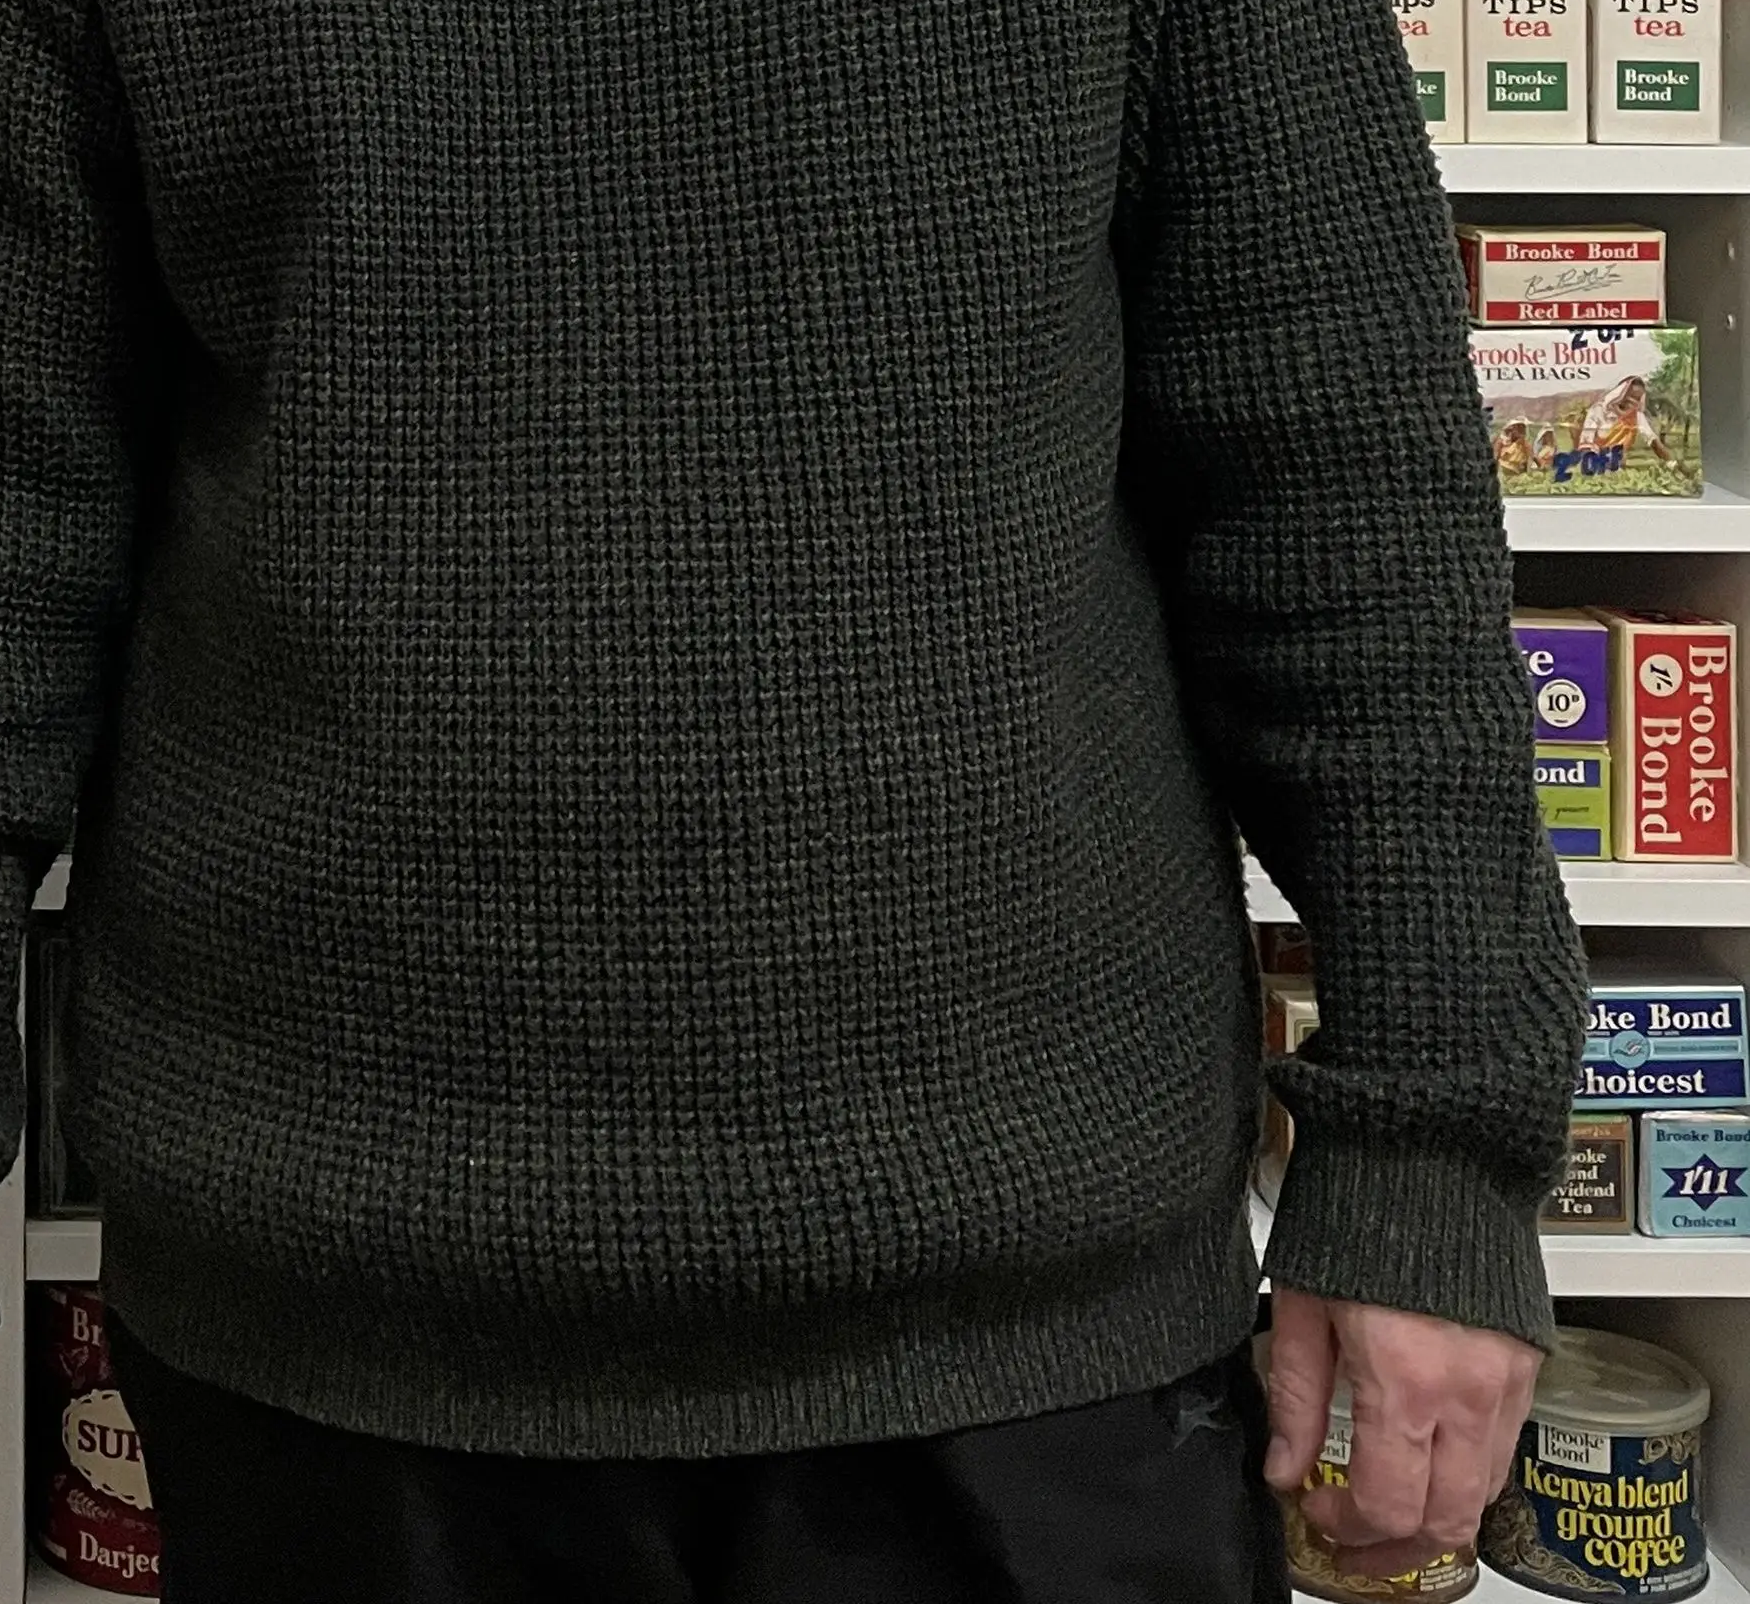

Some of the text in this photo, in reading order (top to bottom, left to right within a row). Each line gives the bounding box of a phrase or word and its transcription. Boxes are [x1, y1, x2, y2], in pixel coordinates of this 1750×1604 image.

[1634, 15, 1685, 38] tea
[1505, 243, 1639, 262] Brooke Bond
[1518, 302, 1627, 322] Red Label
[1481, 367, 1590, 382] TEA BAGS
[1686, 644, 1727, 824] Brooke
[1640, 716, 1683, 843] Bond
[1648, 1003, 1732, 1032] Bond
[1671, 1212, 1737, 1230] Choicest
[1523, 1456, 1689, 1511] Kenya blend
[1556, 1508, 1671, 1543] ground
[1584, 1534, 1685, 1577] coffee
